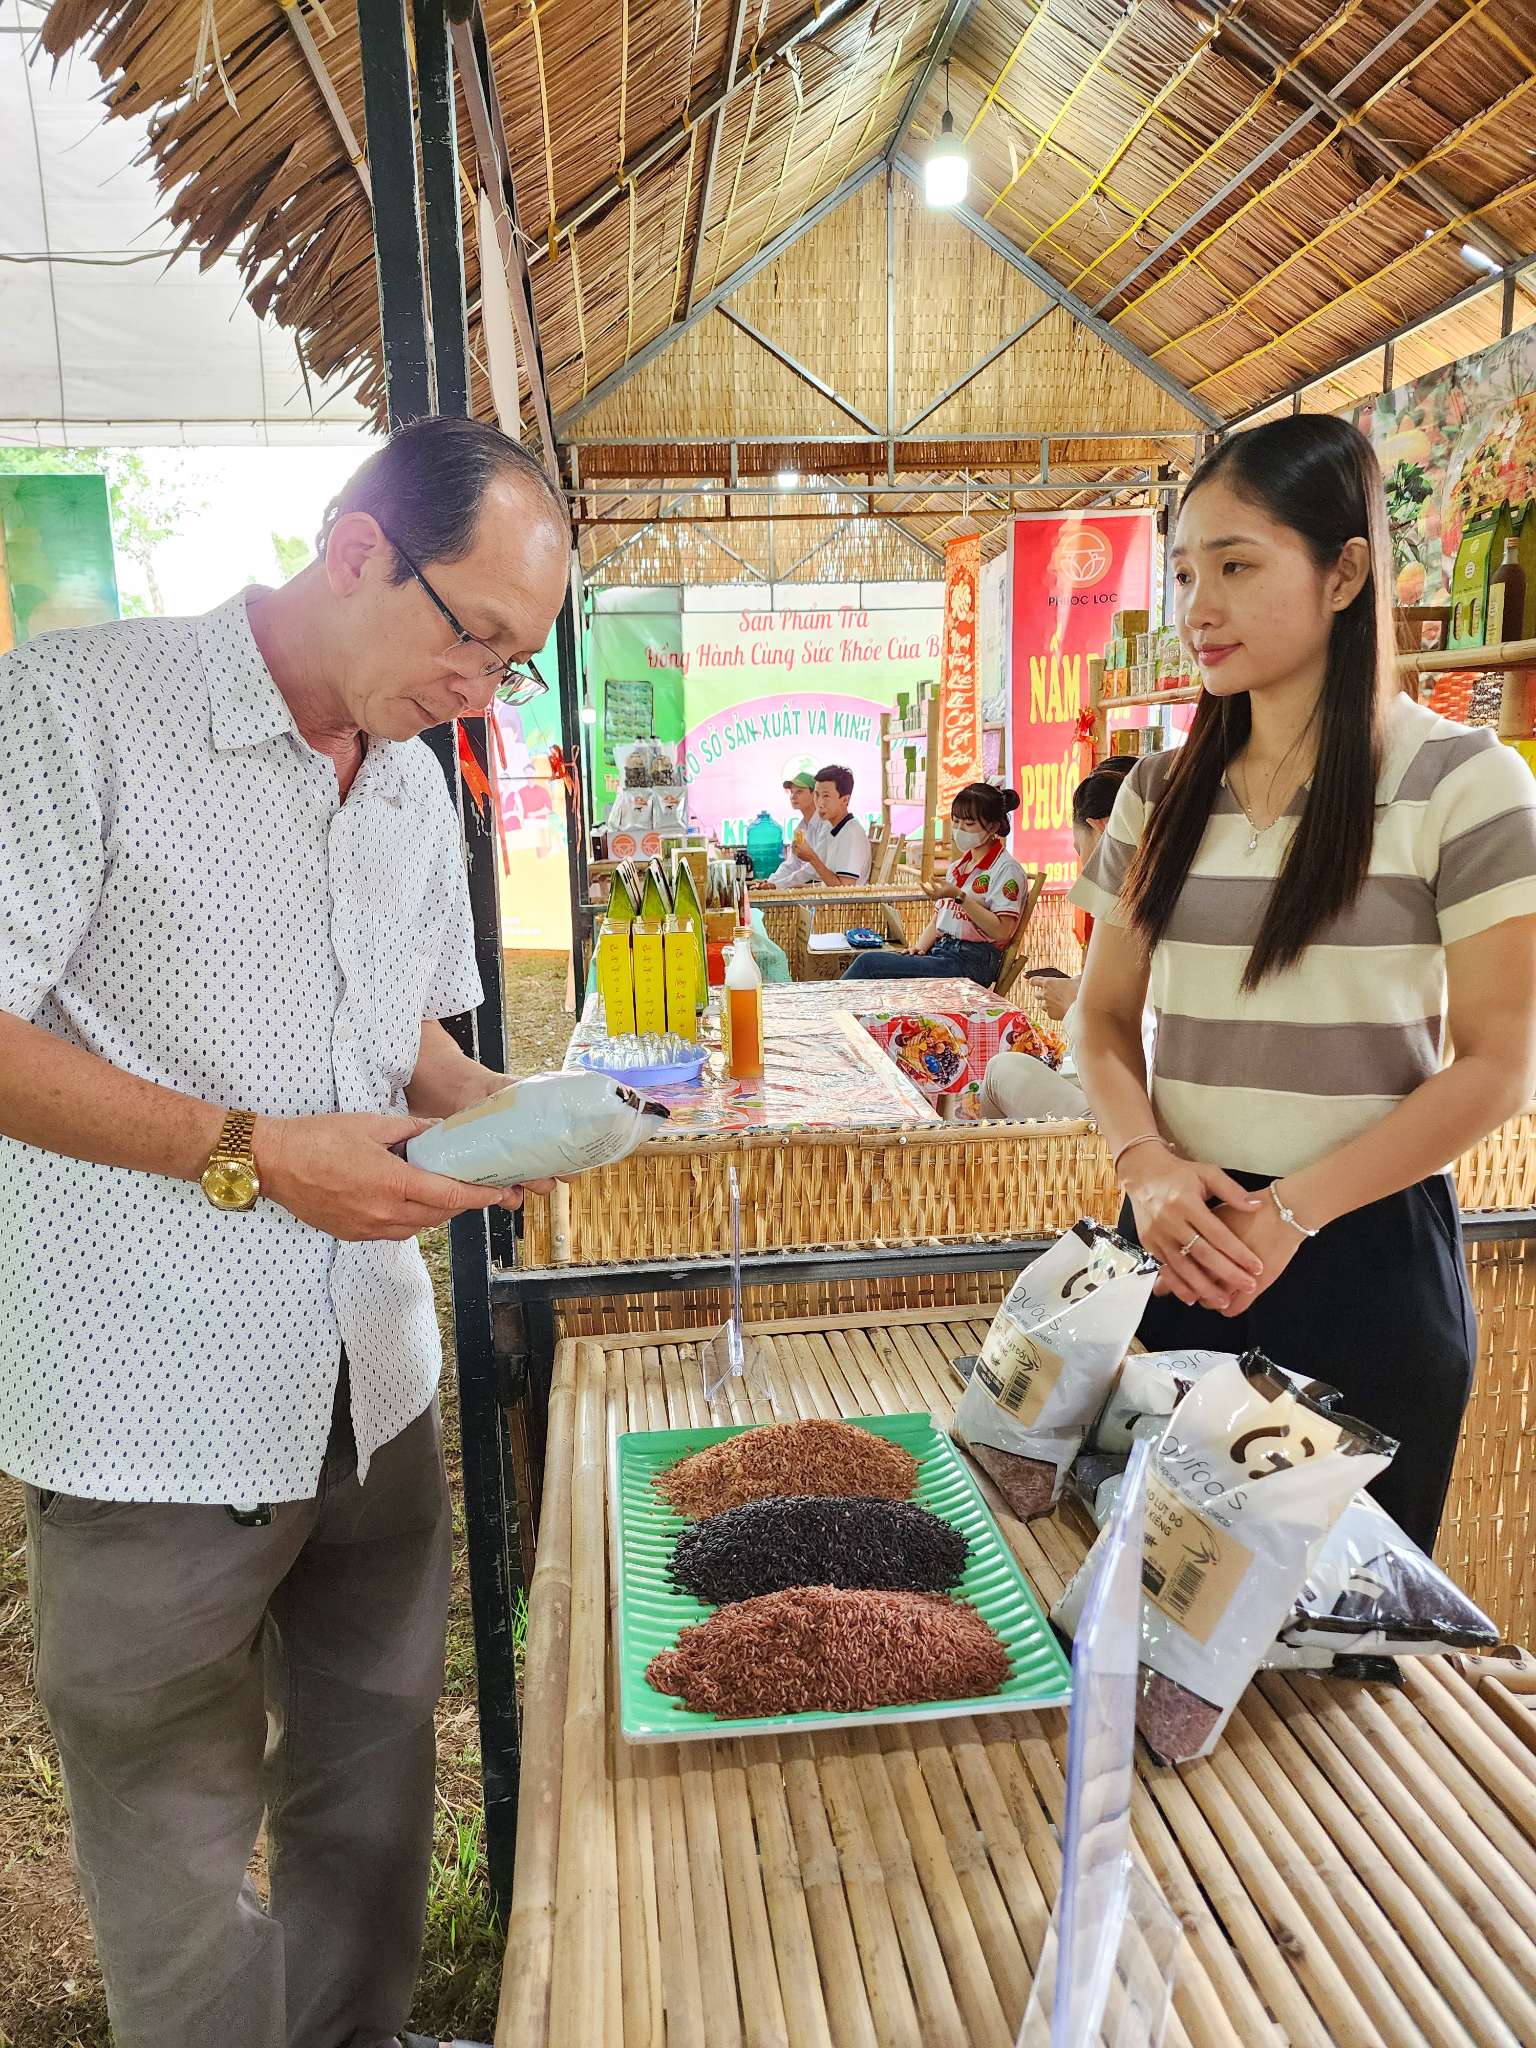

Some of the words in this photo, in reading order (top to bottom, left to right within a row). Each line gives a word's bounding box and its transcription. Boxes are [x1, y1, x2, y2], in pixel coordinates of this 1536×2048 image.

[696, 643, 745, 667] Hành
[751, 640, 796, 672] Cùng
[801, 638, 834, 664] Sức
[886, 635, 921, 661] Của
[724, 712, 757, 750] SẢN
[760, 700, 801, 740] XUẤT
[806, 703, 827, 736] VÀ
[833, 711, 872, 742] KINH
